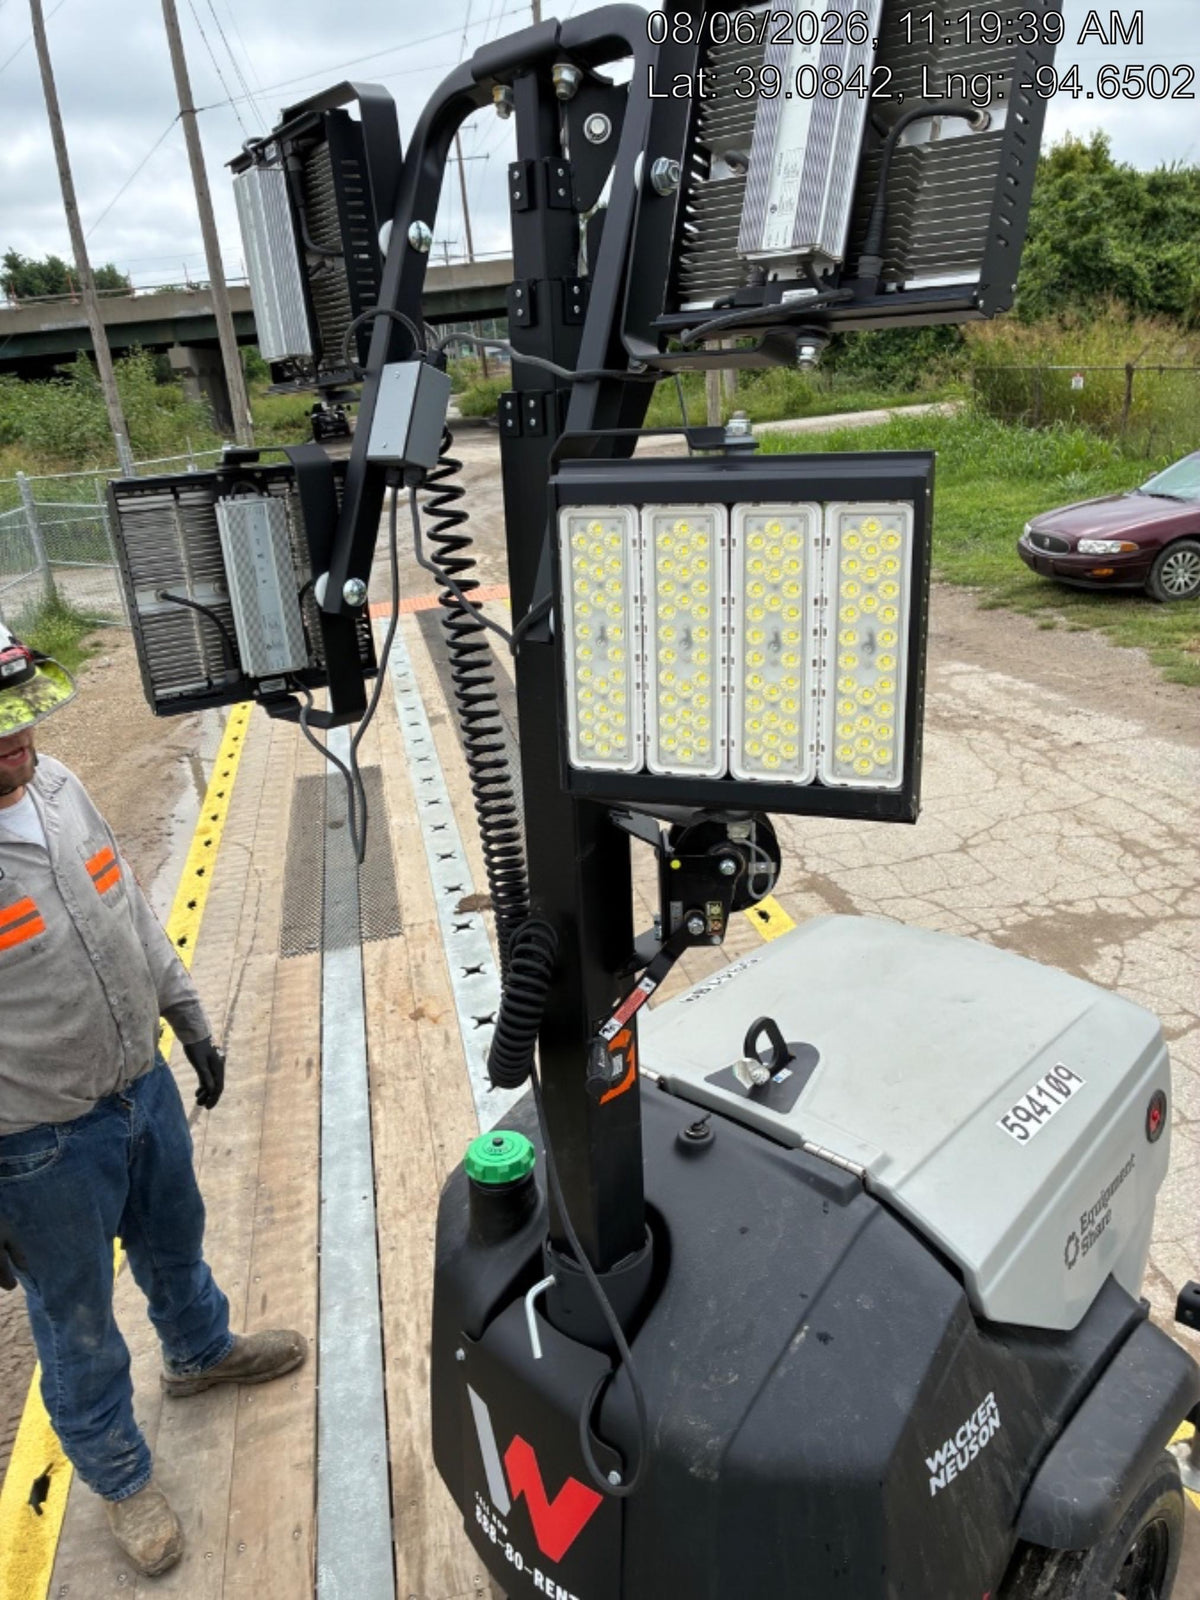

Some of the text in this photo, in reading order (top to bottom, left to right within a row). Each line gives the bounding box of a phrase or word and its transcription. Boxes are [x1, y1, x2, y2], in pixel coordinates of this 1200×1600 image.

[1000, 1064, 1084, 1141] 594109
[1079, 1152, 1136, 1236] Equipment
[1080, 1208, 1112, 1258] Share
[925, 1391, 998, 1474] WACKER
[928, 1407, 1001, 1497] NEUSON
